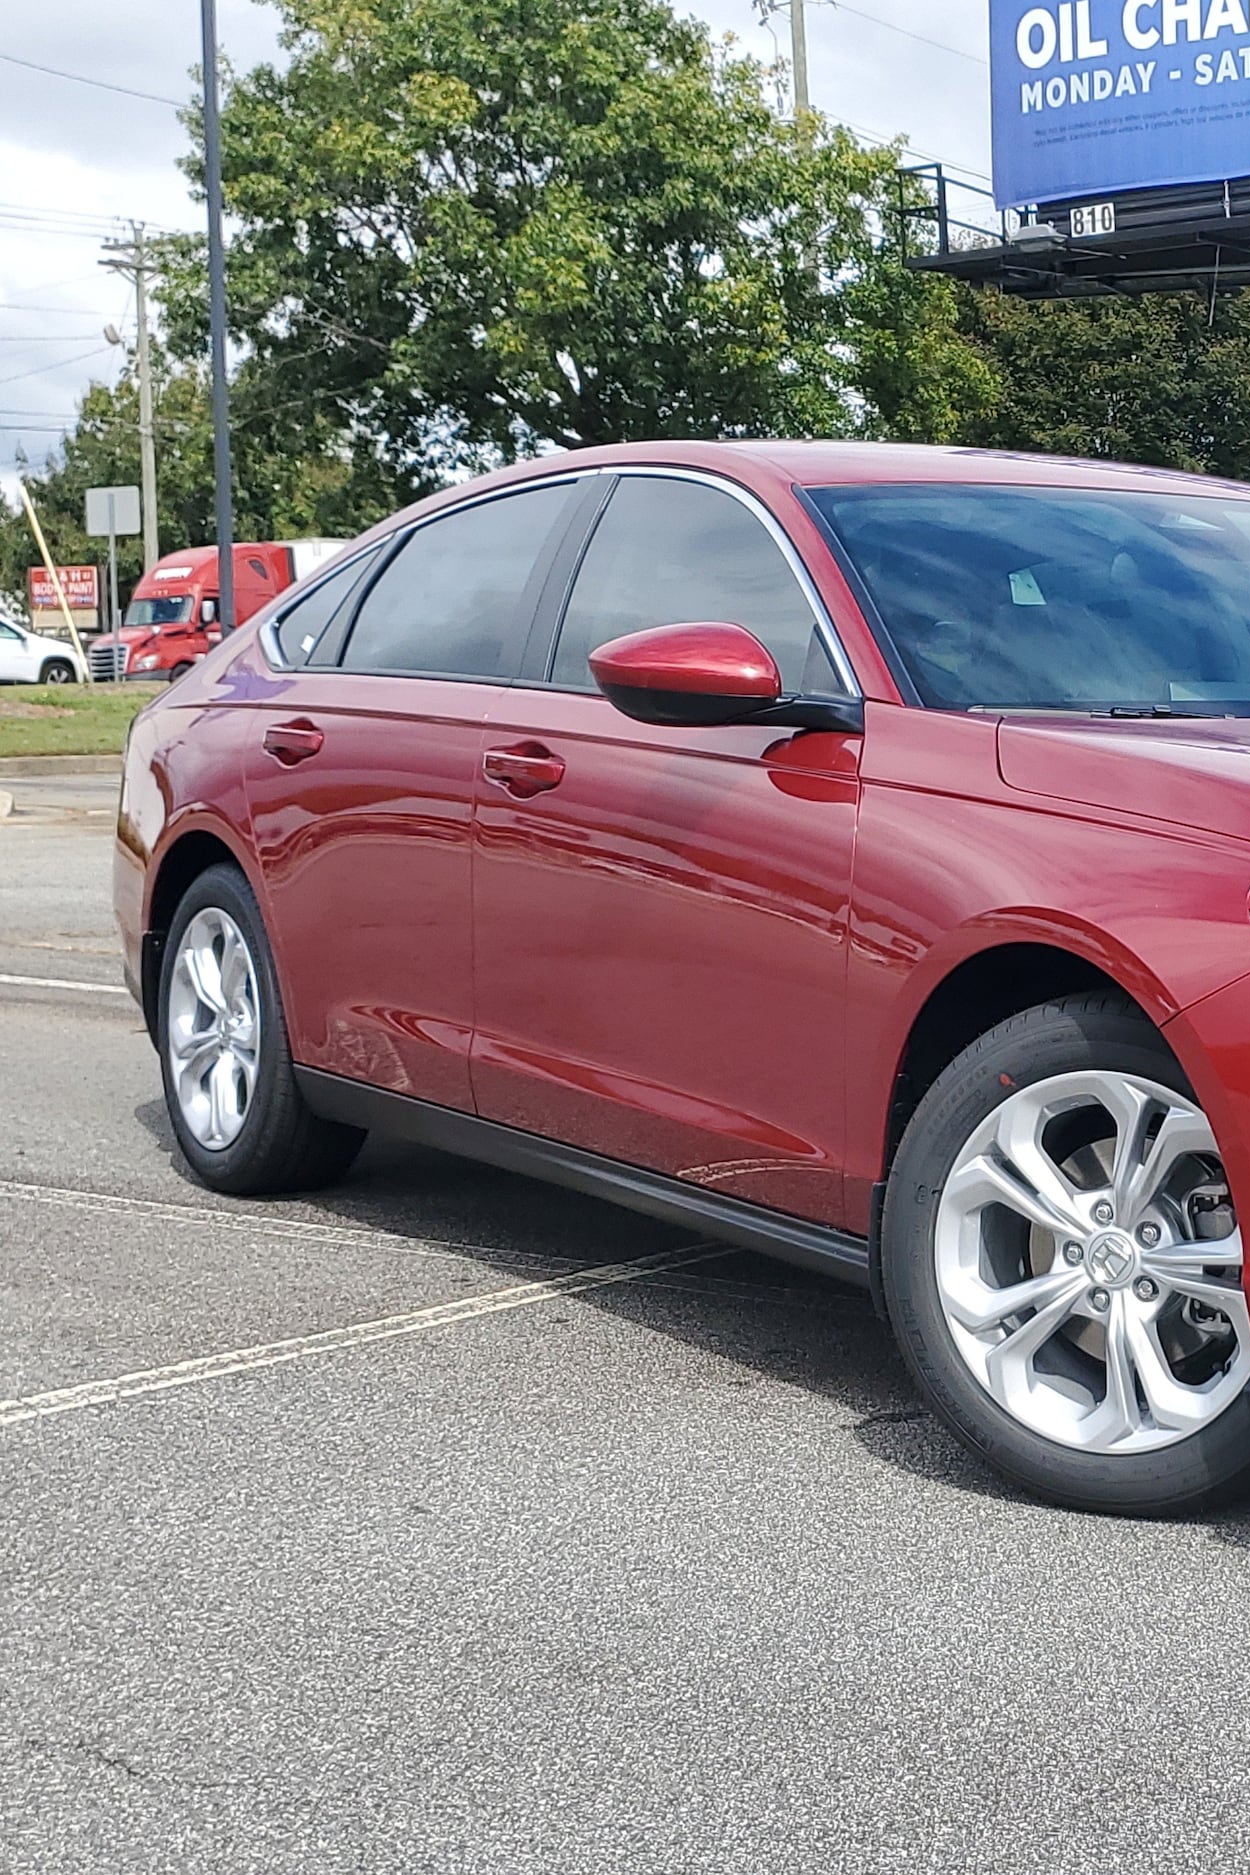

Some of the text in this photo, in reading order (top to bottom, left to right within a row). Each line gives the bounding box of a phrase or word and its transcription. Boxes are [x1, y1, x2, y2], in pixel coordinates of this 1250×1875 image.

[1016, 0, 1108, 69] OIL
[1021, 61, 1156, 113] MONDAY
[1169, 70, 1182, 80] -
[1073, 206, 1113, 235] 810
